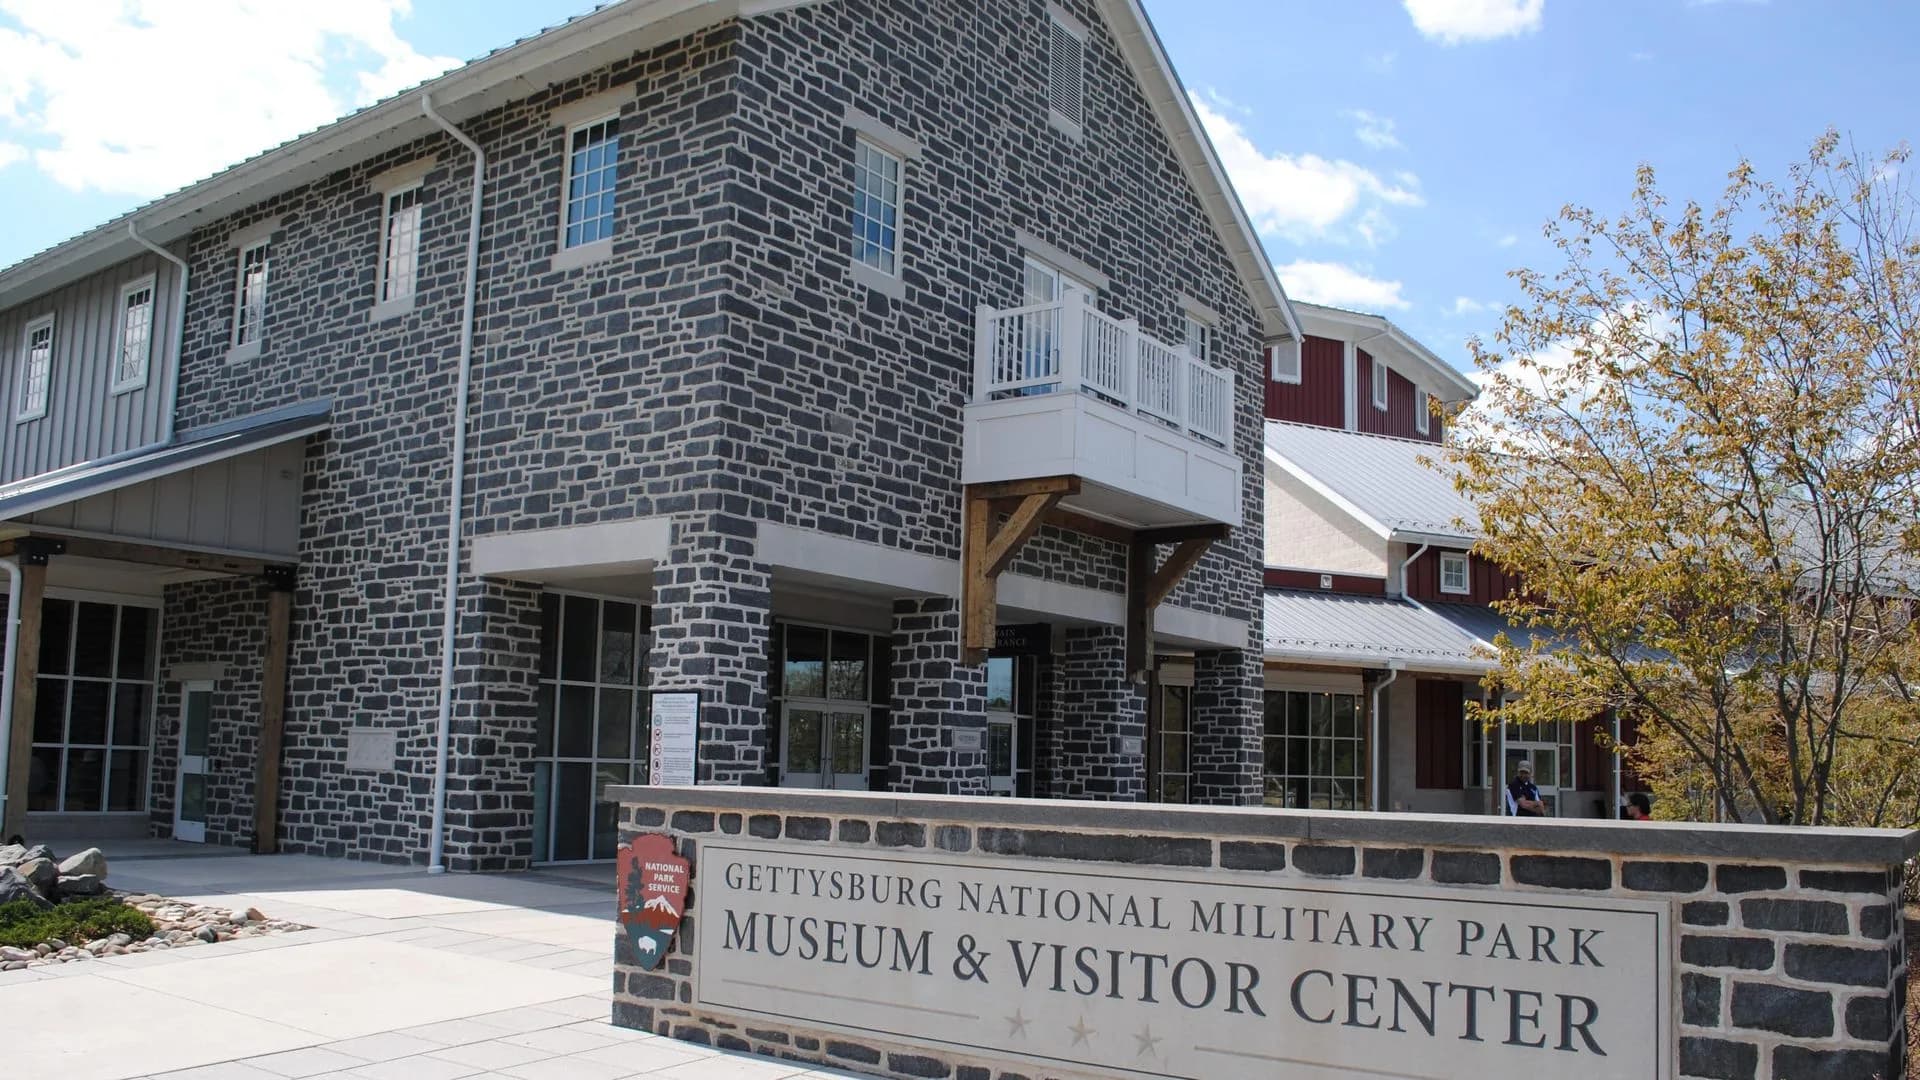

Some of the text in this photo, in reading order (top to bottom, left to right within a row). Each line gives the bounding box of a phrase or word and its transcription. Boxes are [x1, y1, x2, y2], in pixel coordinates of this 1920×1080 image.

[645, 862, 685, 873] NATIONAL
[653, 874, 675, 883] PARK
[647, 883, 681, 894] SERVICE
[725, 862, 1606, 968] GETTYSBURG NATIONAL MILITARY PARK
[722, 909, 1608, 1057] MUSEUM & VISITOR CENTER
